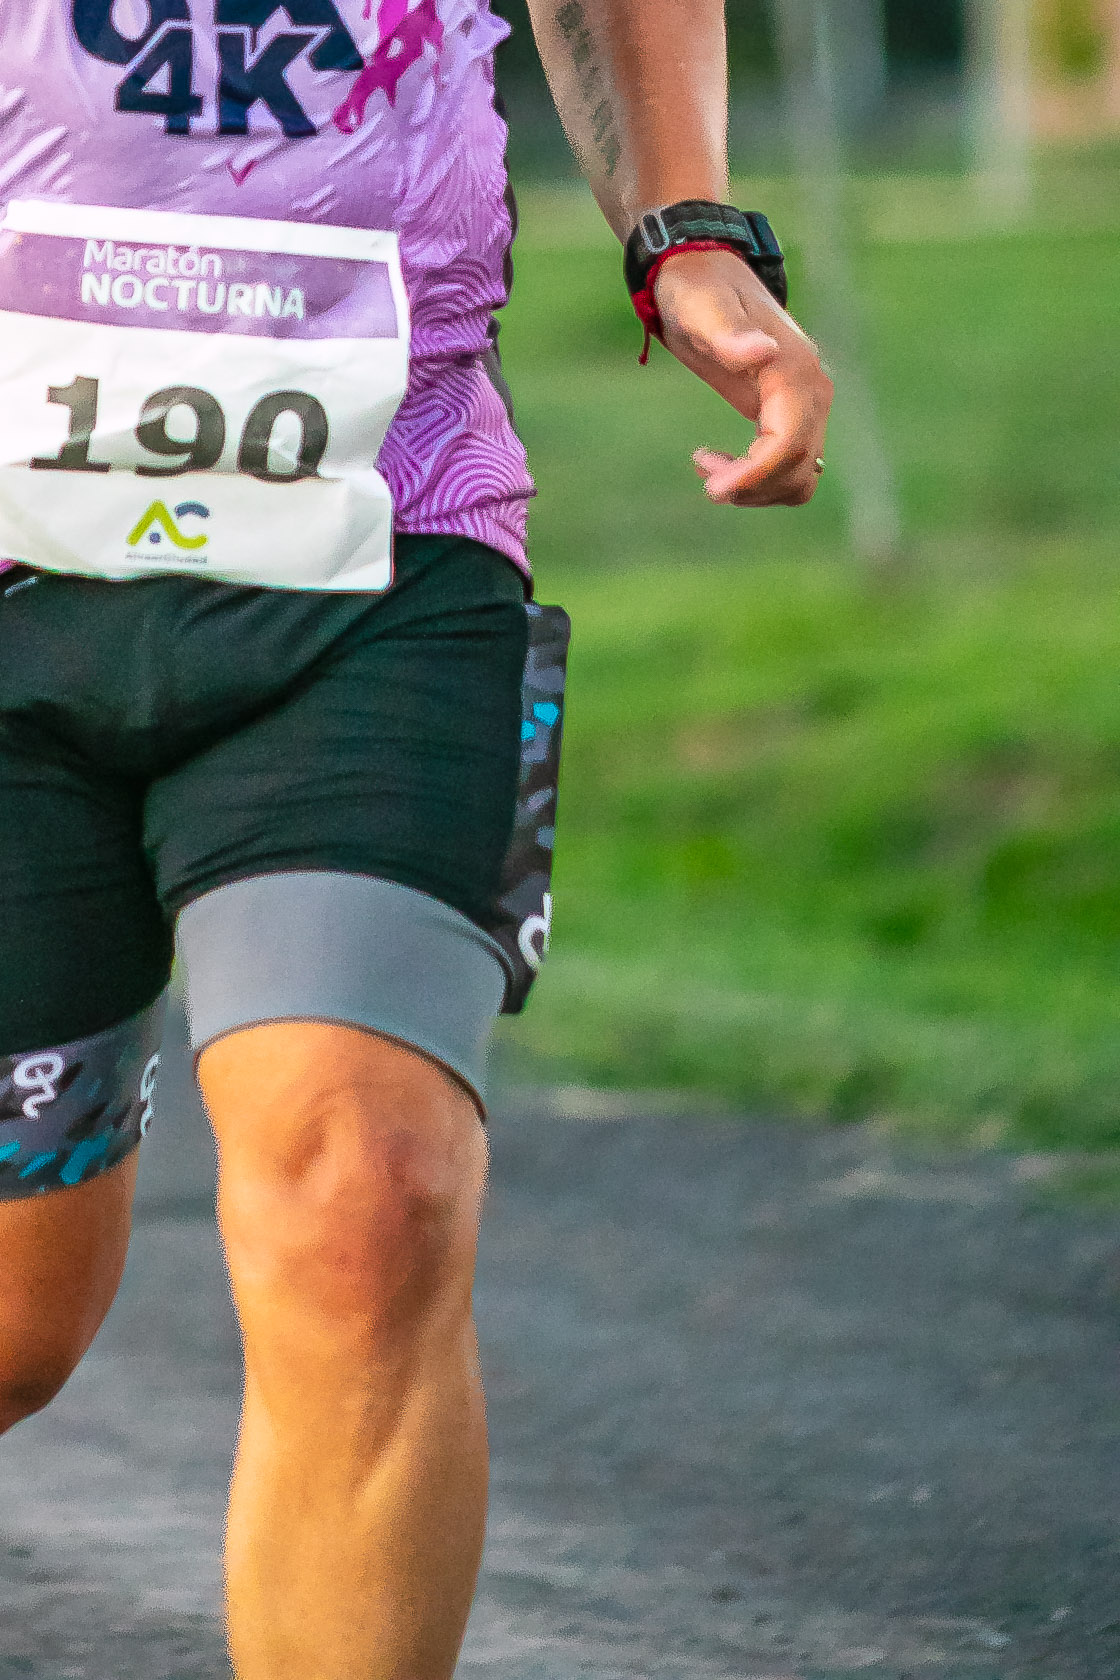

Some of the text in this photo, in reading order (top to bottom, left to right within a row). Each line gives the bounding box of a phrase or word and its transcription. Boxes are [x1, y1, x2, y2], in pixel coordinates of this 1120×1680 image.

[115, 30, 318, 138] 4K
[80, 273, 307, 320] NOCTURNA
[82, 239, 223, 279] Maratón
[29, 374, 330, 483] 190
